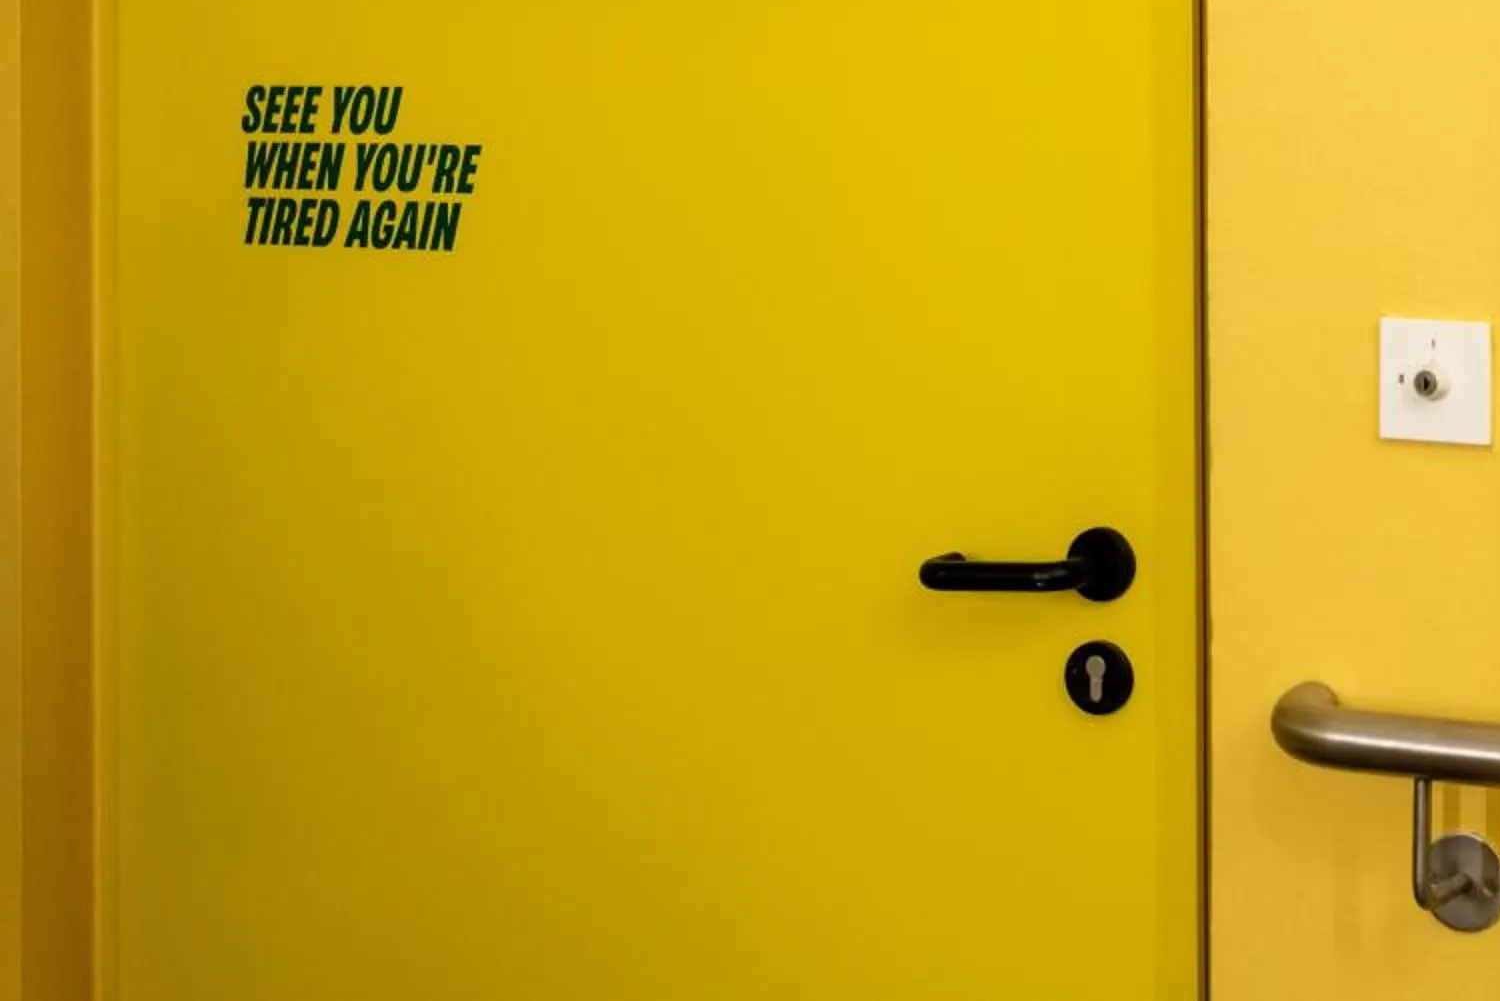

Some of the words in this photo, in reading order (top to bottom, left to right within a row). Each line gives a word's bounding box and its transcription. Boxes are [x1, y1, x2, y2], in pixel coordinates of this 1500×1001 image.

[241, 85, 322, 134] SEEE
[331, 86, 403, 135] YOU
[244, 141, 346, 190] WHEN
[354, 143, 482, 194] YOU'RE
[244, 197, 341, 247] TIRED
[344, 199, 462, 251] AGAIN
